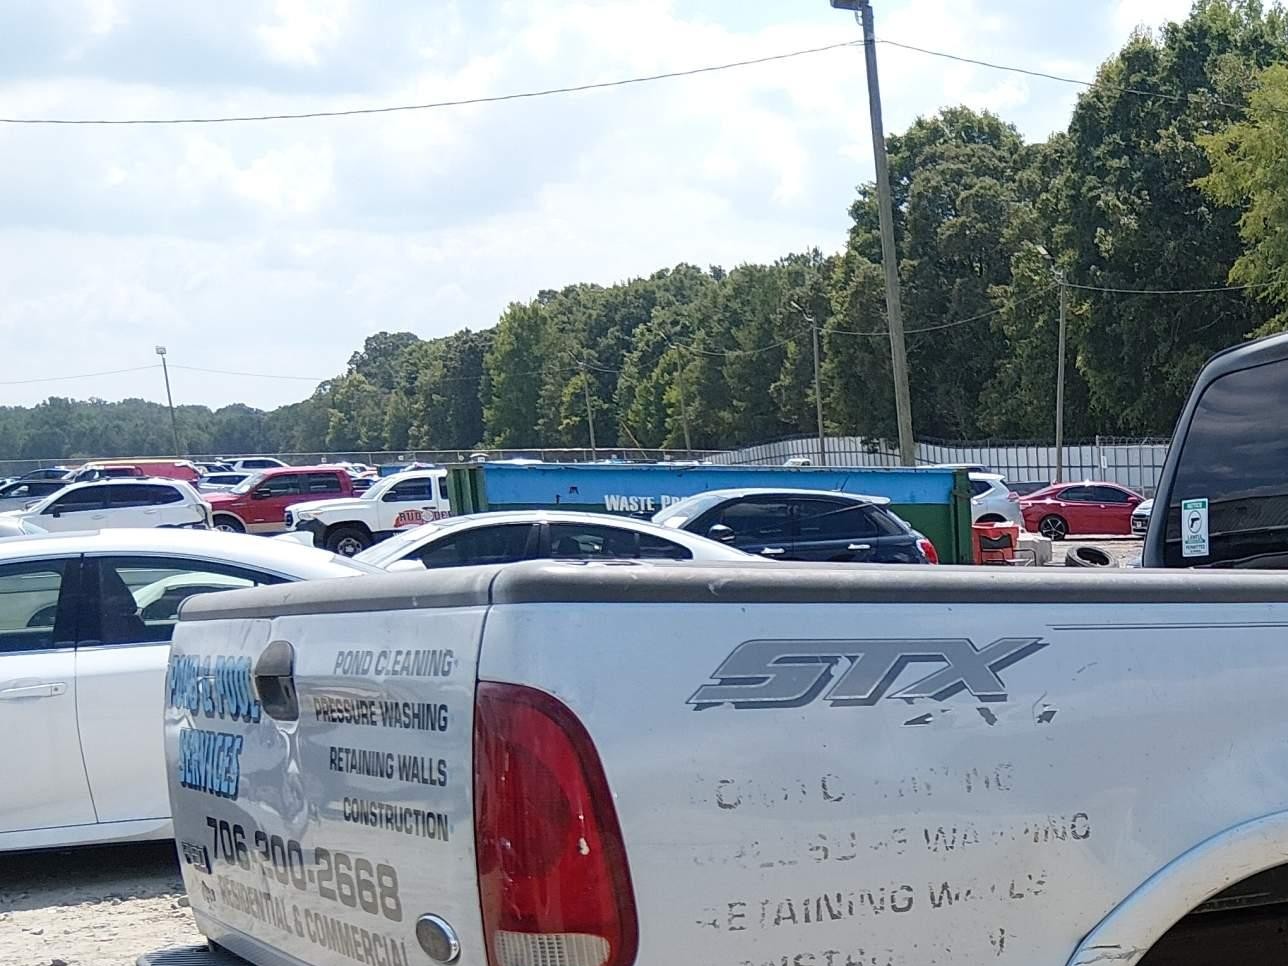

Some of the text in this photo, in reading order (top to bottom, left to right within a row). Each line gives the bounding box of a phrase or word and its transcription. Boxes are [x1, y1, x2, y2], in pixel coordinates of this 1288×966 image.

[604, 495, 656, 512] WASTE
[335, 650, 454, 677] POND CLEANING
[687, 637, 1050, 710] STX
[313, 697, 449, 732] PRESSURE WASHING
[329, 746, 448, 787] RETAINING WALLS
[343, 797, 449, 842] CONSTRUCTION
